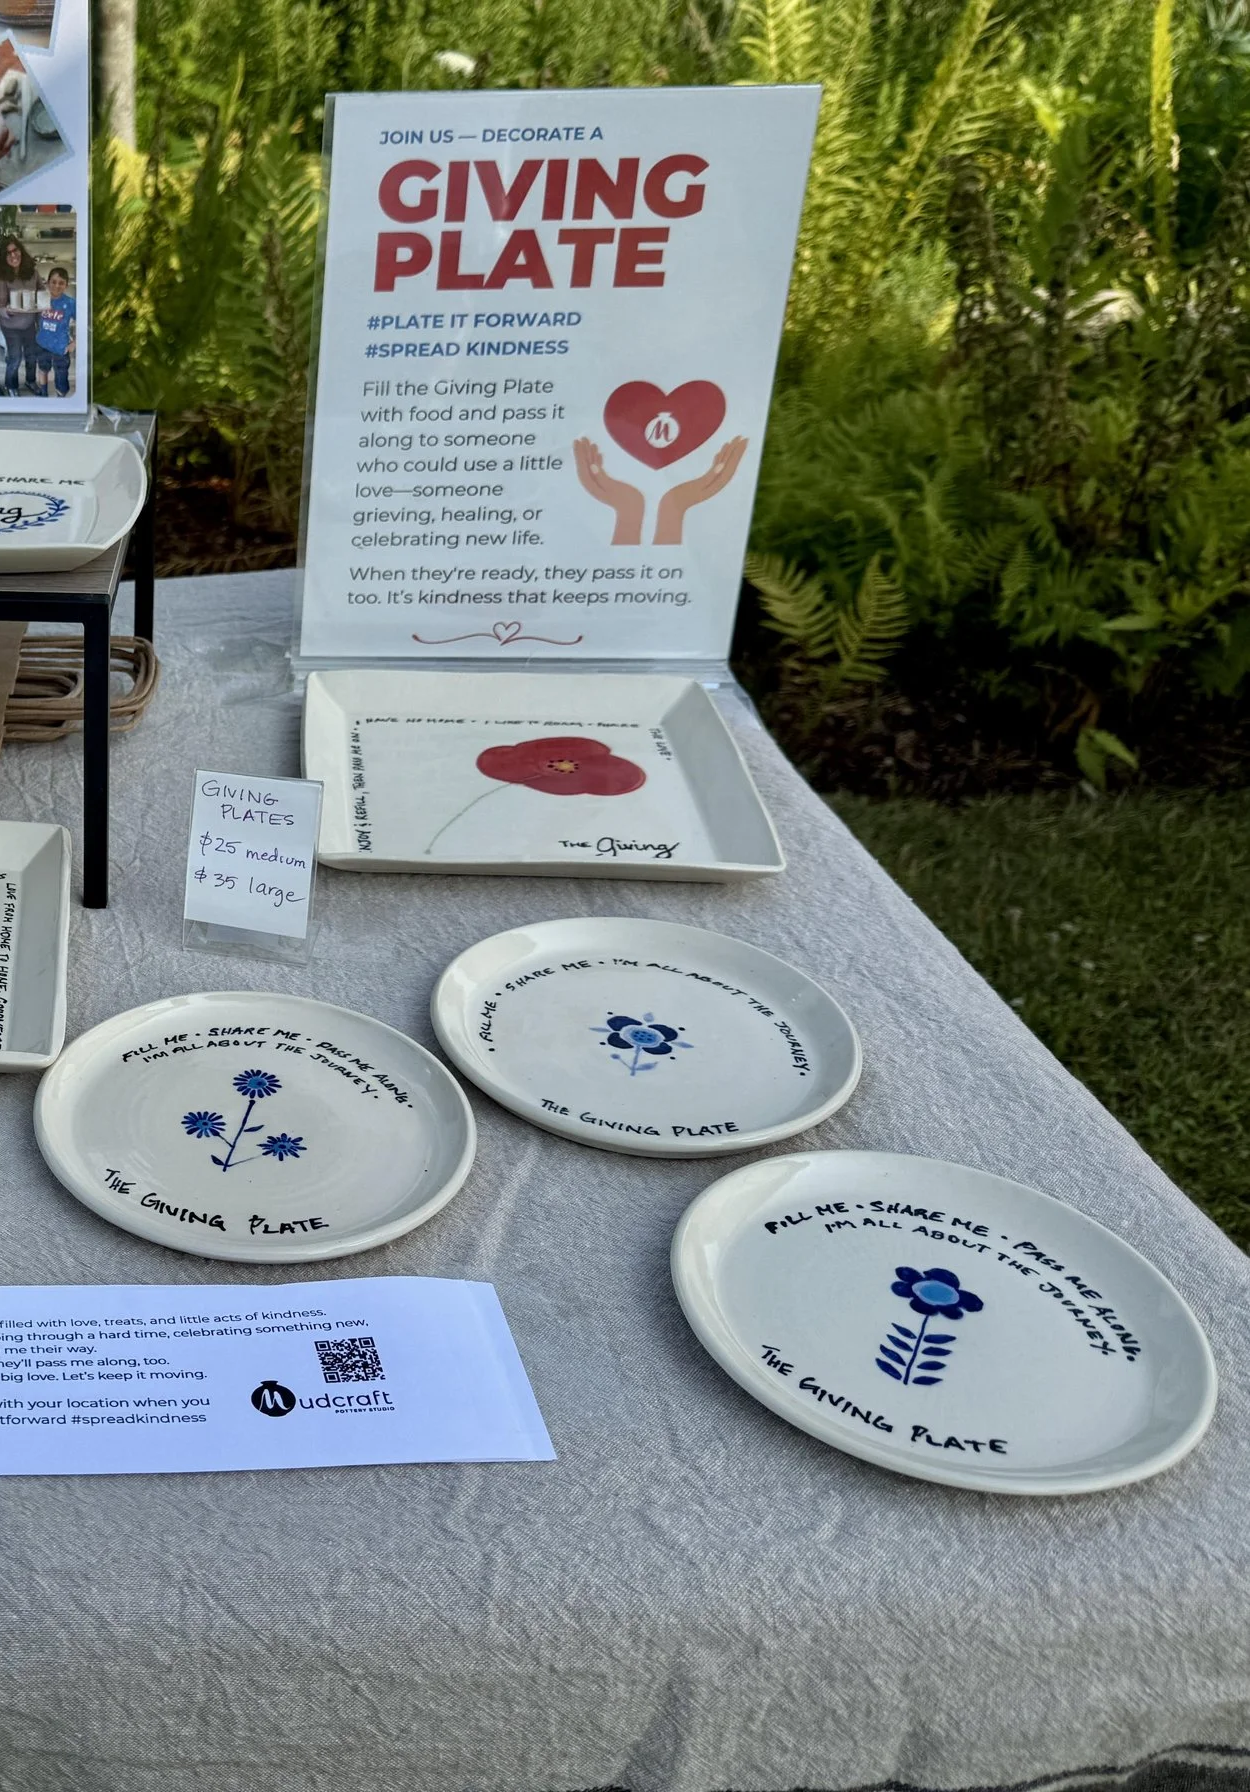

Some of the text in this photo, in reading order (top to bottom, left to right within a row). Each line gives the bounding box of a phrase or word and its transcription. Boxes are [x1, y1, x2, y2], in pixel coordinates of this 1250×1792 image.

[380, 127, 603, 145] JOIN US DECORATE A
[378, 153, 709, 223] GIVING
[373, 227, 670, 293] PLATE
[367, 312, 581, 330] #PLATE IT FORWARD
[365, 340, 568, 358] #SPREAD KINDNESS
[363, 379, 553, 398] Fill the Giving Plate
[361, 404, 564, 424] with food and pass it
[359, 433, 536, 451] along to someone
[357, 455, 563, 472] who could use a little
[353, 506, 542, 526] grieving, healing, or
[351, 530, 543, 549] celebrating new life.
[350, 565, 683, 583] When they're ready, they pass it on
[348, 589, 691, 606] too. It's kindness that keeps moving.
[202, 780, 278, 809] GIVING
[221, 804, 294, 825] PLATES
[200, 831, 305, 869] $25 medium
[558, 839, 591, 850] THE
[249, 877, 305, 907] large
[121, 1027, 301, 1063] FILL ME SHARE ME
[542, 1099, 739, 1137] THE GIVING PLATE
[105, 1169, 329, 1235] THE GIVING PLATE
[27, 1401, 62, 1410] your
[67, 1398, 129, 1408] location
[133, 1397, 177, 1407] when
[181, 1398, 210, 1408] you
[258, 1388, 393, 1412] Mudcraft
[761, 1345, 1007, 1454] THE GIVING PLATE
[71, 1413, 206, 1426] #spreadkindness
